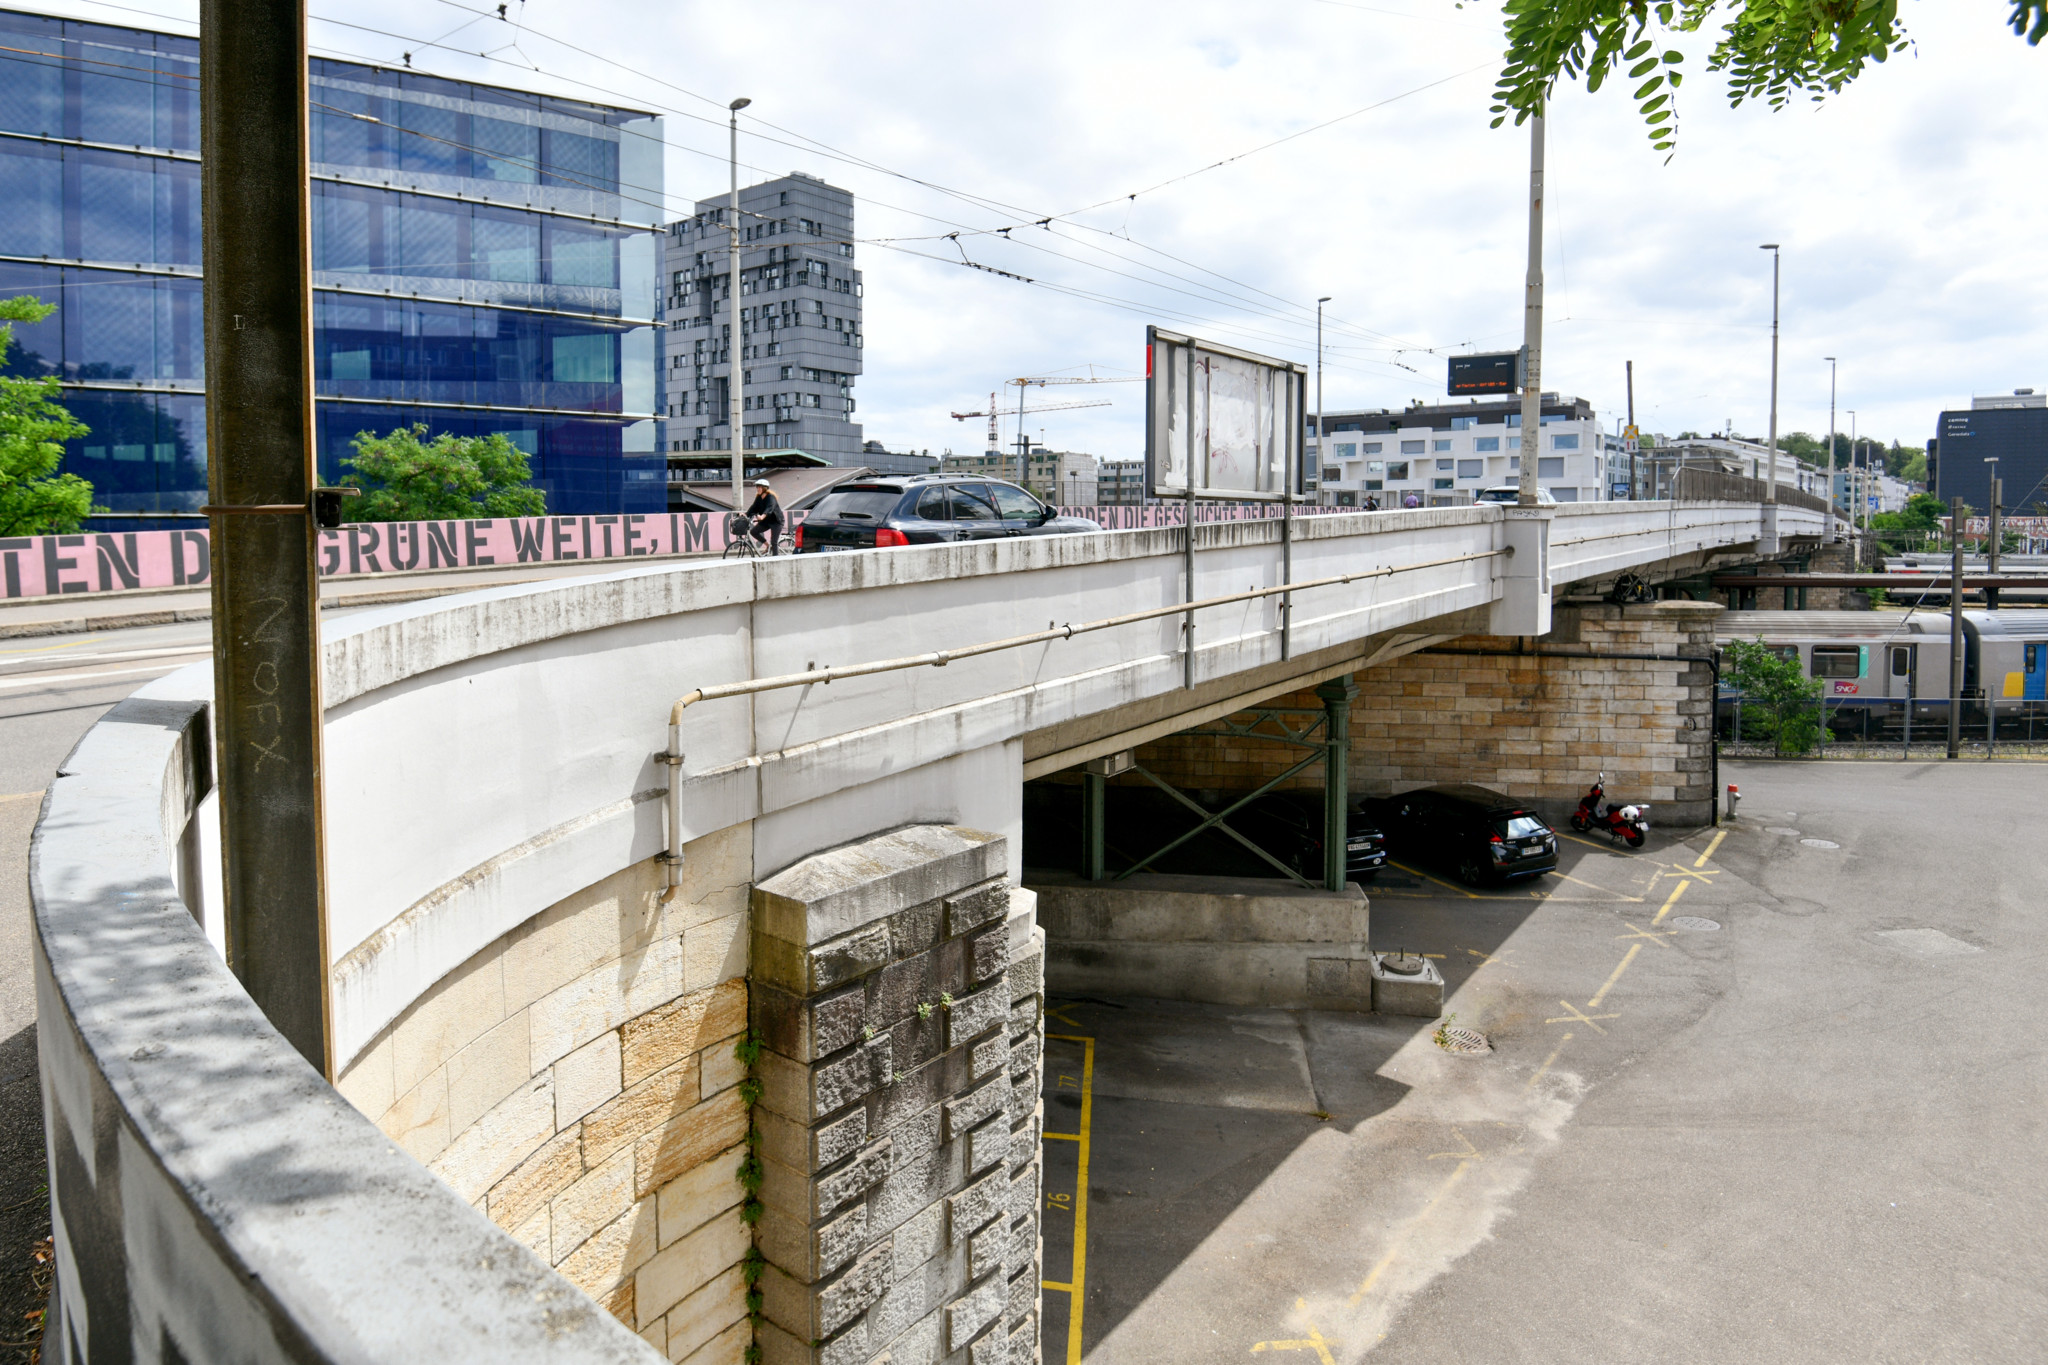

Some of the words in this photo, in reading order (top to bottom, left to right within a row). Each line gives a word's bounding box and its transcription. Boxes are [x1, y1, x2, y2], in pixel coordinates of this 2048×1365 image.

[1124, 506, 1149, 530] DIE
[318, 520, 495, 576] GRÜNE
[510, 514, 659, 562] WEITE,
[670, 513, 709, 553] IM
[1861, 646, 1868, 654] 2
[1835, 685, 1857, 693] SNCF
[1058, 1074, 1078, 1088] 77
[1046, 1192, 1071, 1211] 76
